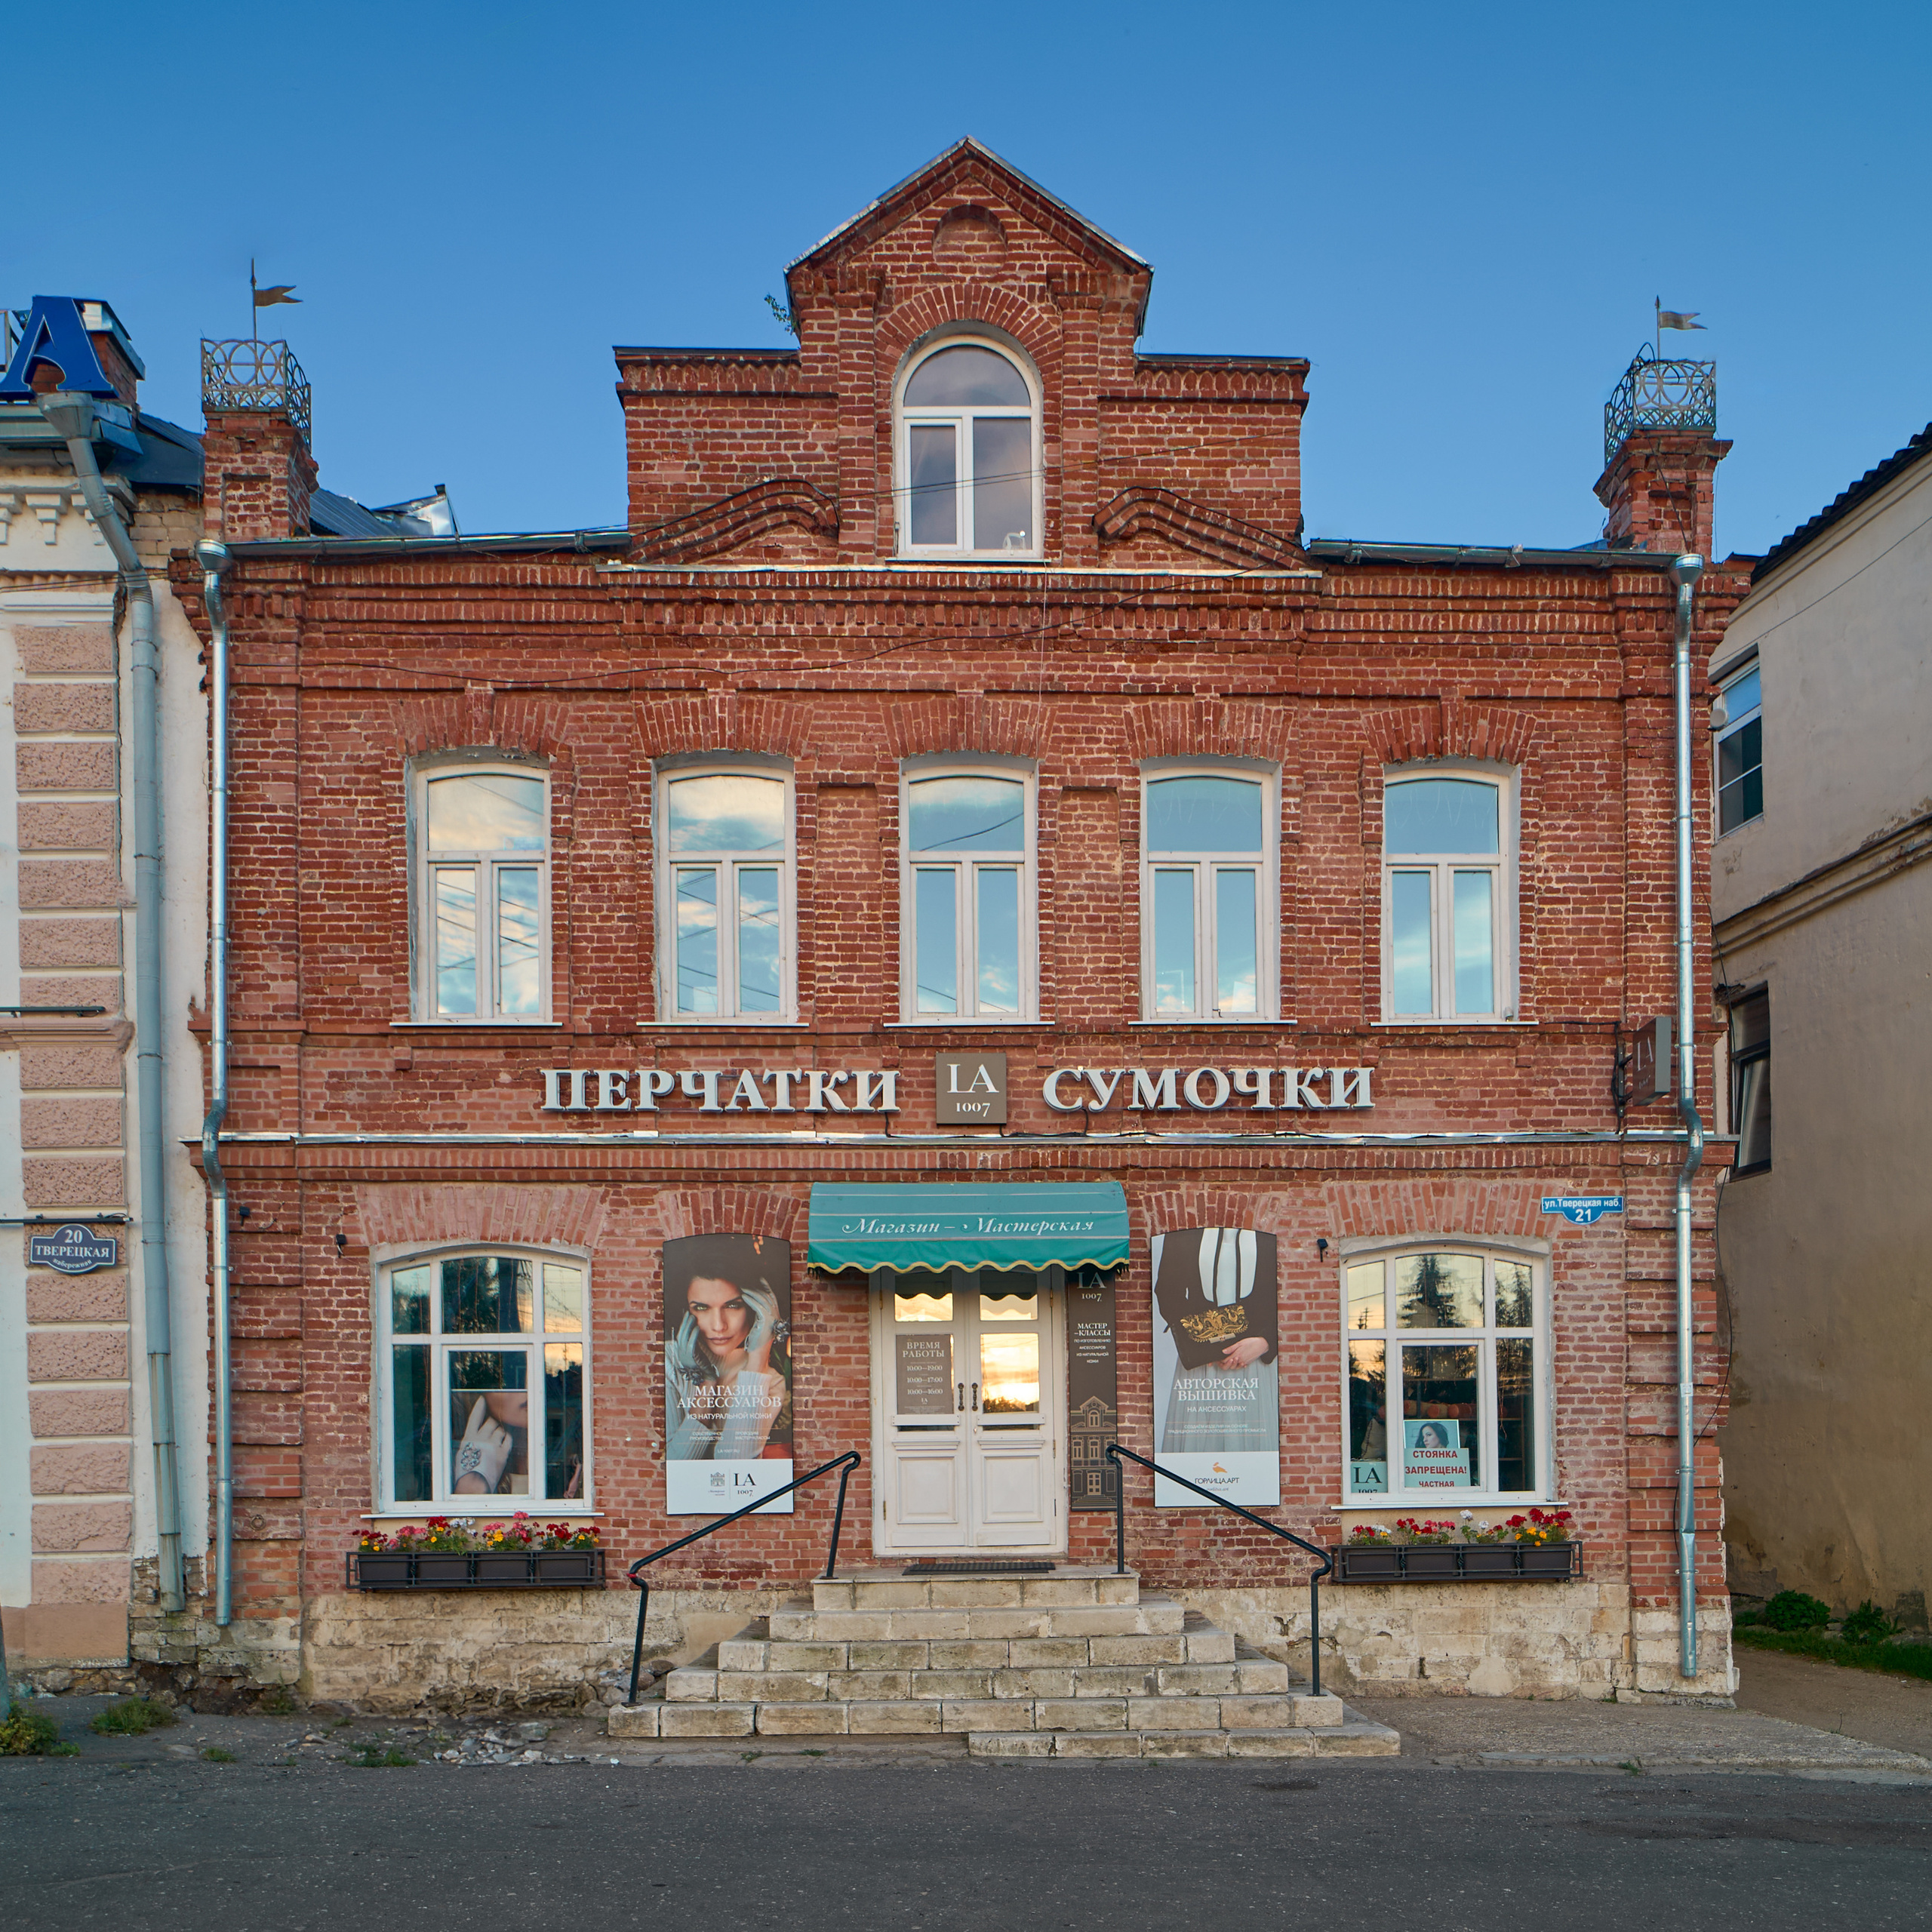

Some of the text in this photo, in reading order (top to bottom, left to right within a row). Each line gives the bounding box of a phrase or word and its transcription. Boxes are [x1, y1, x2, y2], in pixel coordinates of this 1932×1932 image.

[946, 1063, 1000, 1094] LA
[540, 1068, 902, 1113] ПЕРЧАТКИ
[1042, 1066, 1376, 1112] СУМОЧКИ
[956, 1102, 991, 1118] 1007
[1604, 1197, 1621, 1207] наб.
[1575, 1209, 1592, 1222] 21
[841, 1218, 941, 1234] Магазин
[960, 1217, 1094, 1235] Мастерская
[65, 1229, 83, 1244] 20
[35, 1245, 109, 1258] ТВЕРЕЦКАЯ
[53, 1258, 92, 1269] набережная
[1077, 1272, 1107, 1289] LA
[906, 1341, 940, 1349] ВРЕМЯ
[1174, 1378, 1260, 1389] АВТОРСКАЯ
[694, 1385, 764, 1396] МАГАЗИН
[1178, 1389, 1256, 1401] ВЫШИВКА
[676, 1397, 782, 1408] АКСЕССУАРОВ
[1354, 1467, 1382, 1483] LA
[1405, 1466, 1467, 1475] ЗАПРЕЩЕНА!
[734, 1473, 757, 1486] LA
